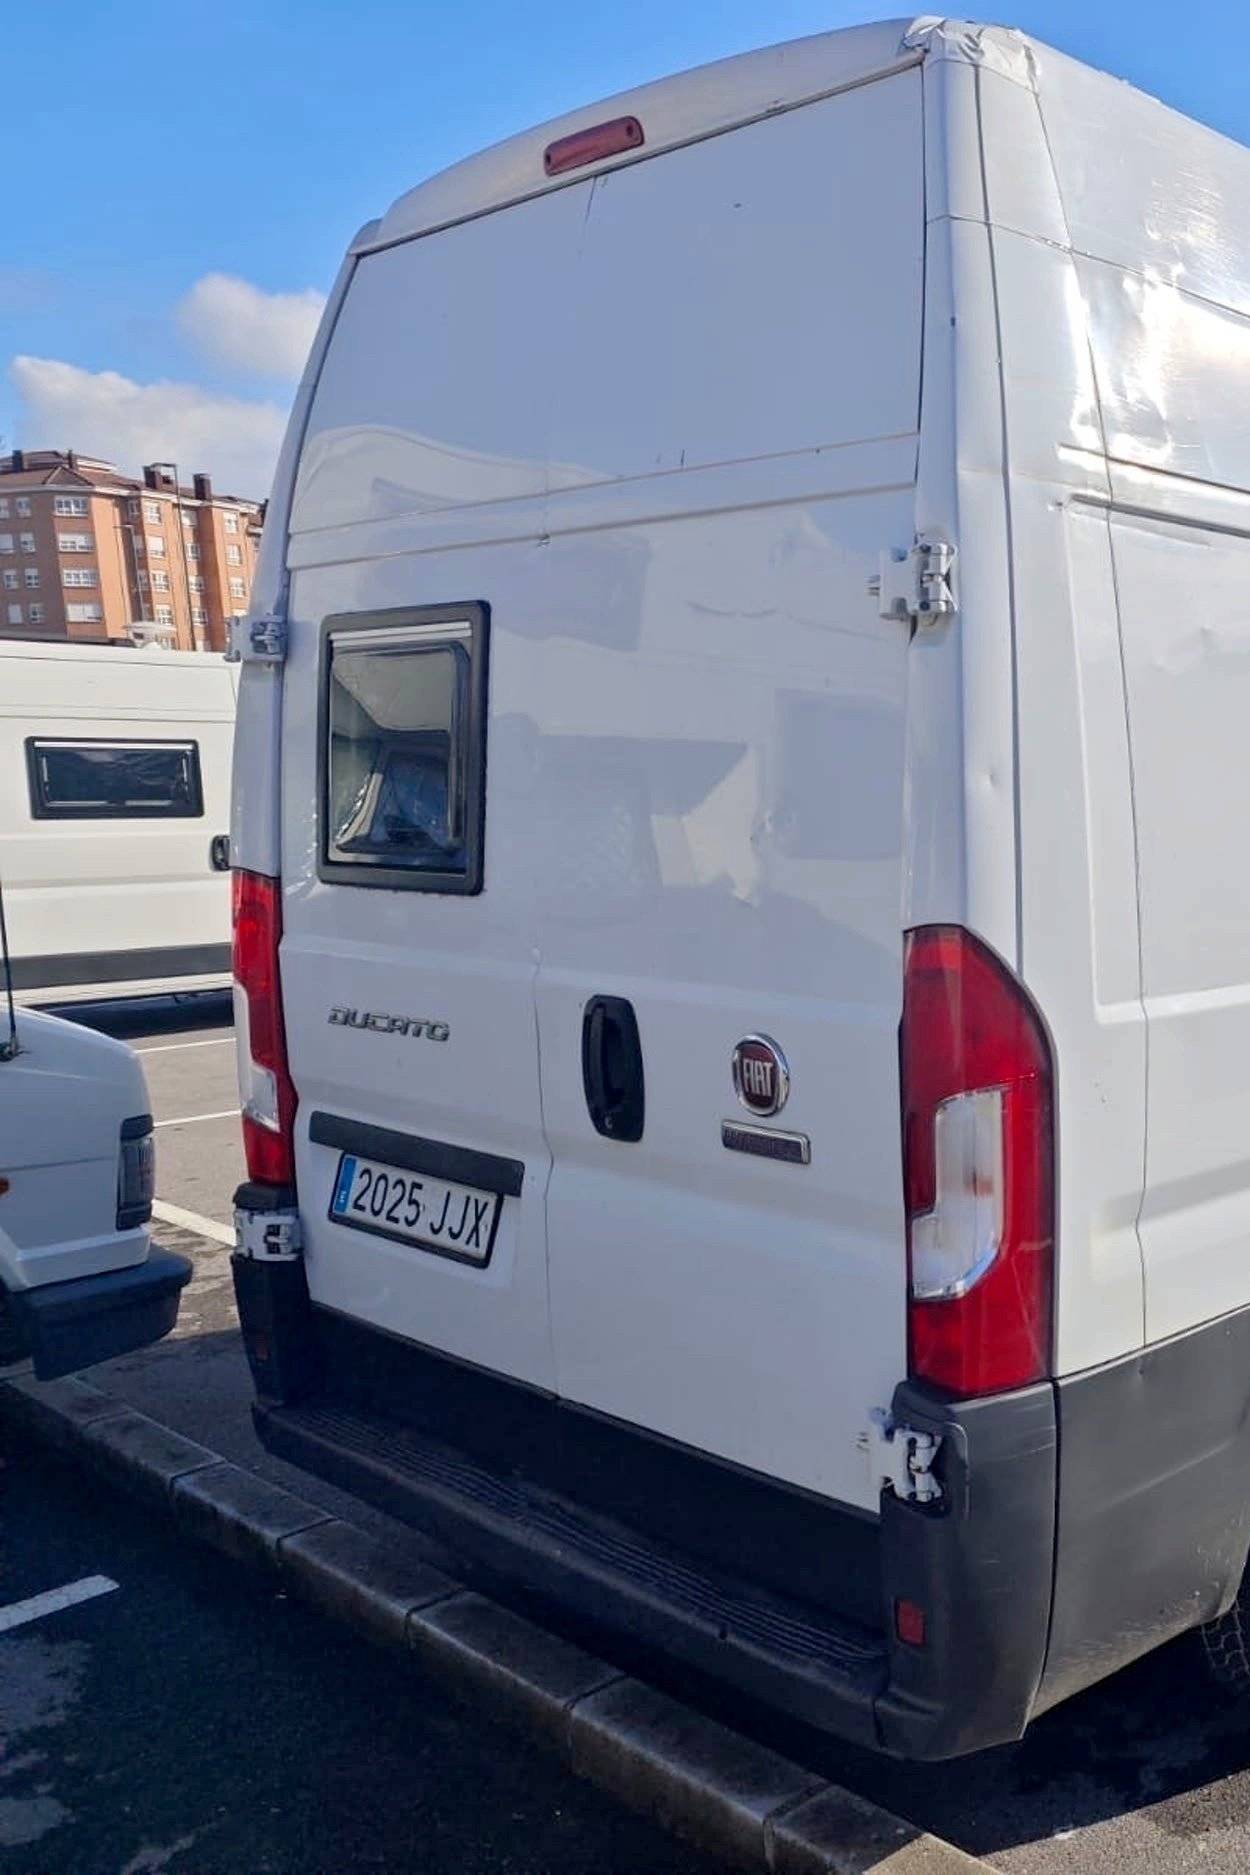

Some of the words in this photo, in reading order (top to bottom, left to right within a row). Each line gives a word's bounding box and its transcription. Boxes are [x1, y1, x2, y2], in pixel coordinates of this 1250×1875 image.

[329, 1007, 449, 1041] DUCATO
[743, 1058, 773, 1096] FIAT
[352, 1168, 423, 1227] 2025
[430, 1191, 488, 1248] JJX
